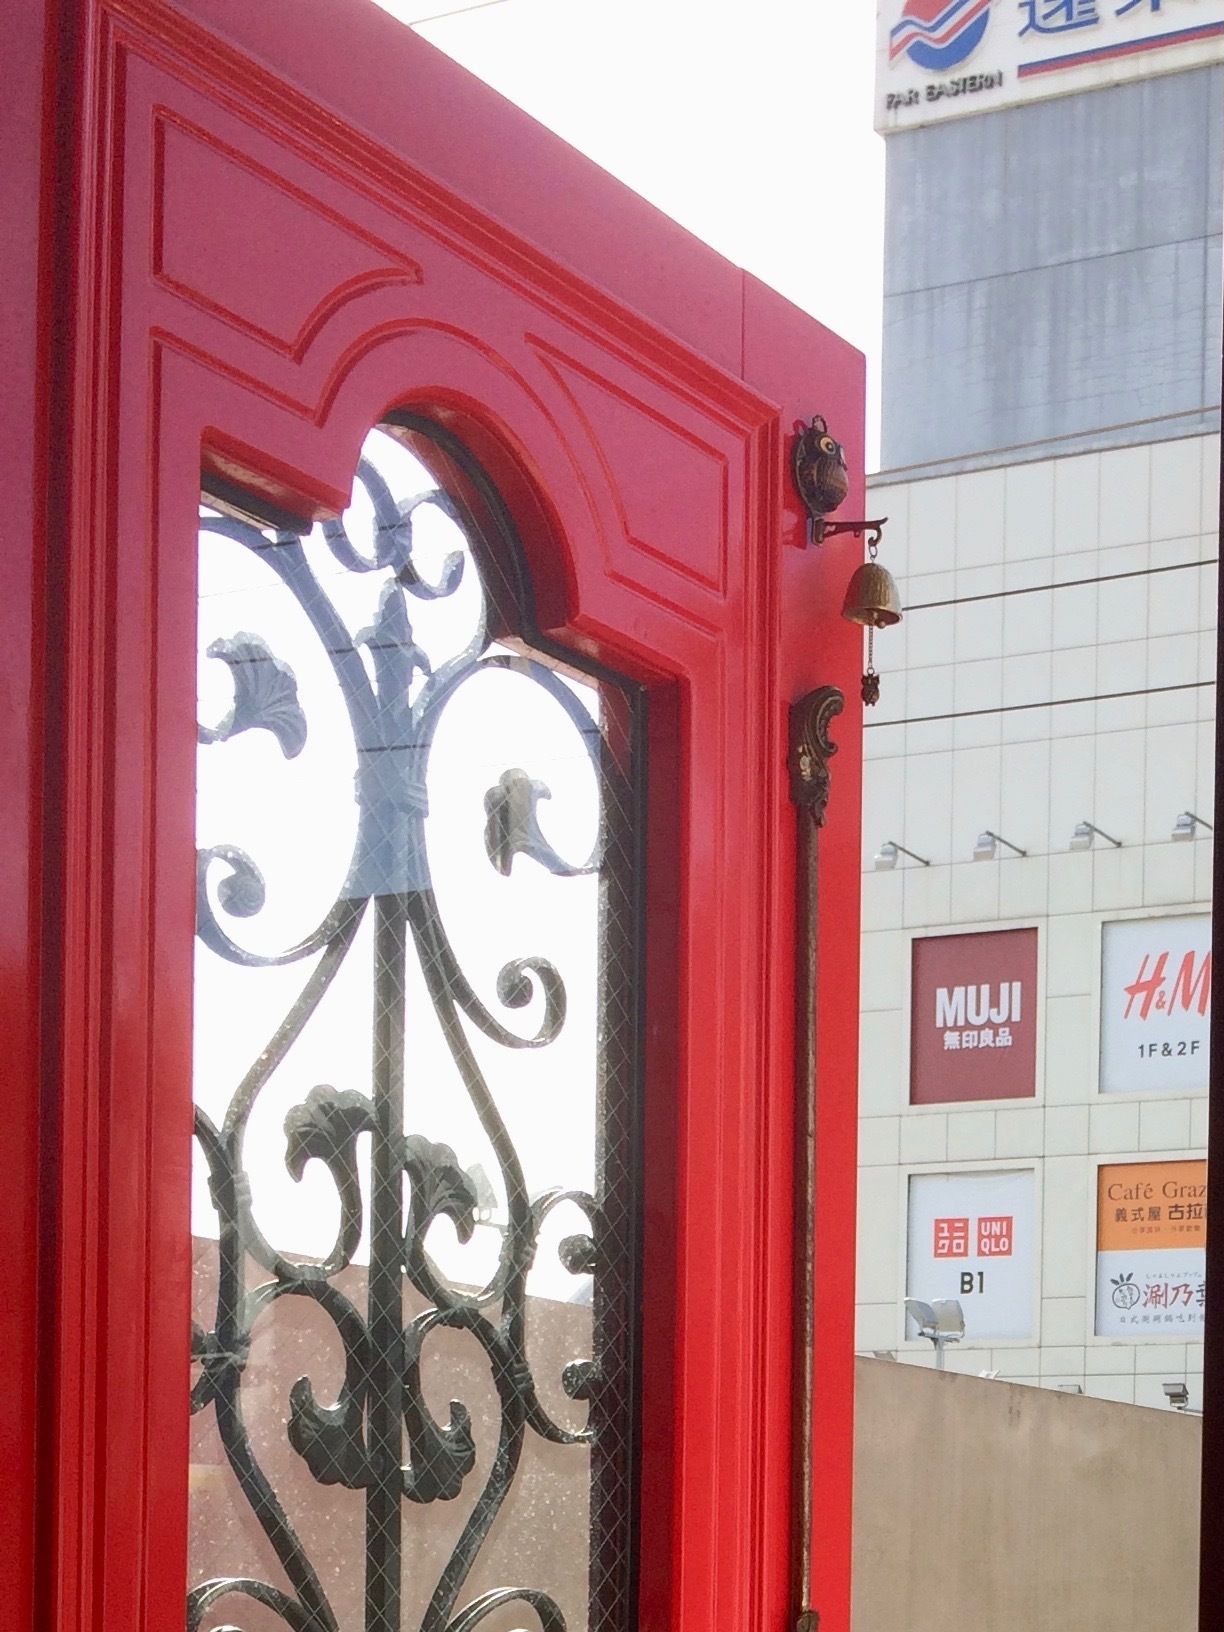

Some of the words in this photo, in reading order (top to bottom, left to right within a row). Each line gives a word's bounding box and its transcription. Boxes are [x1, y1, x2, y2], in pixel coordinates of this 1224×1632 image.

[1123, 950, 1212, 1021] H&M
[935, 981, 1022, 1028] MUJI
[943, 1028, 1013, 1051] 無印良品
[1107, 1181, 1154, 1202] Café
[1114, 1206, 1162, 1223] 義式屋
[1168, 1203, 1207, 1221] 古拉
[980, 1221, 1008, 1237] UNI
[980, 1237, 1009, 1254] QLO
[960, 1271, 985, 1295] B1
